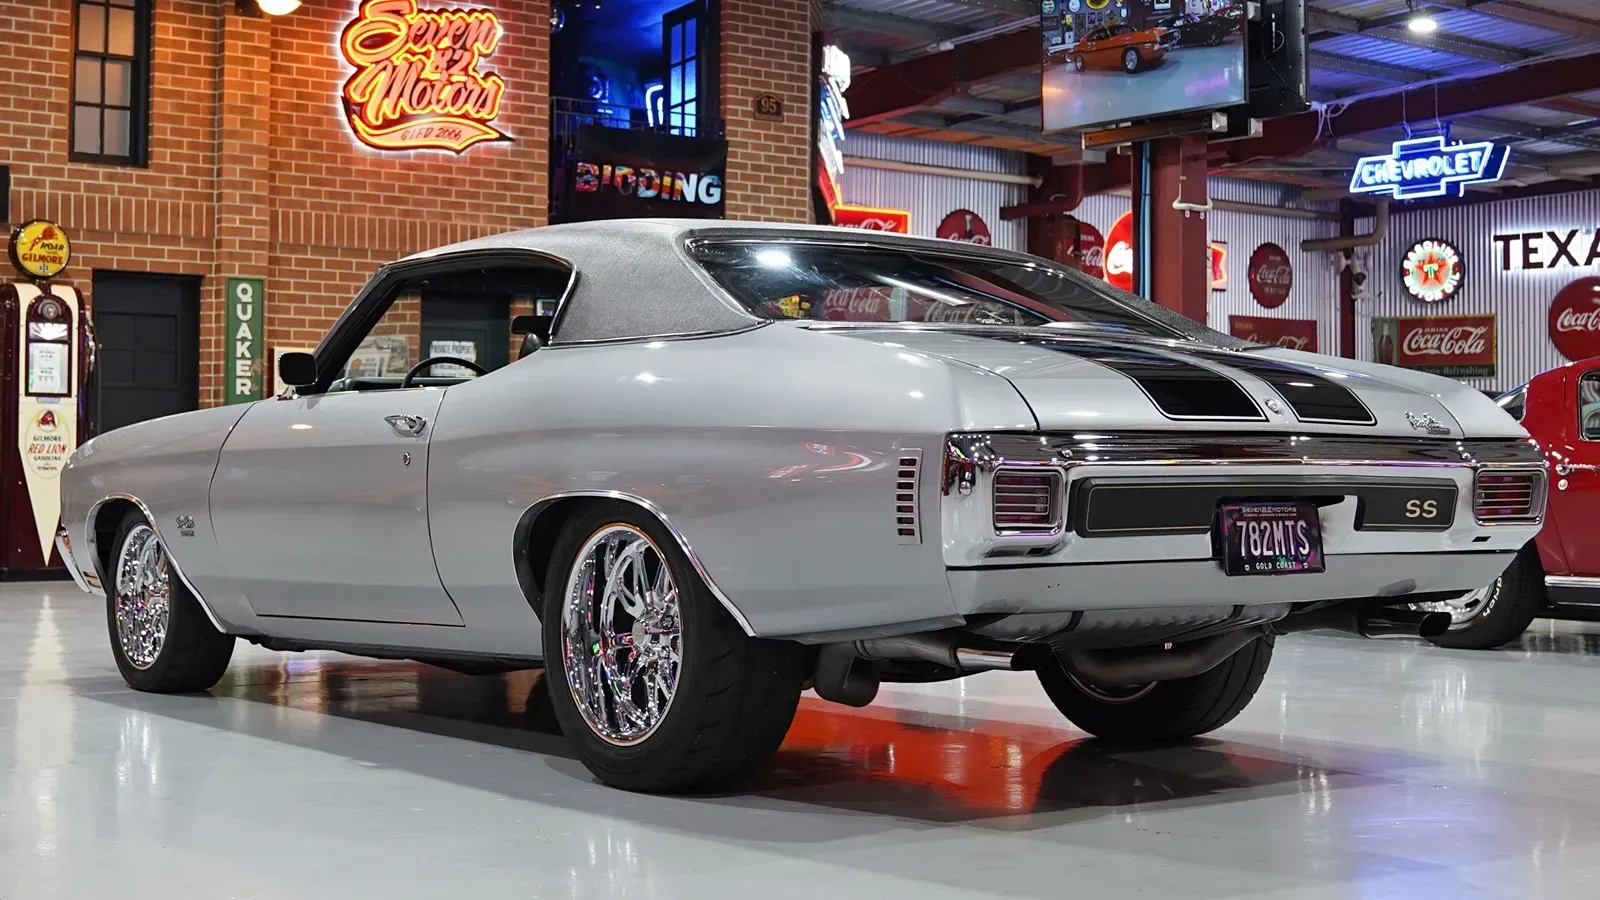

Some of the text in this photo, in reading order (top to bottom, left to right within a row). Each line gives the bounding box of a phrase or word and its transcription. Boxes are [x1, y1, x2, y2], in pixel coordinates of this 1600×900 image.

[347, 0, 502, 66] Seven
[431, 49, 471, 75] 82
[350, 60, 504, 125] Motors
[761, 97, 777, 113] 95
[1361, 151, 1482, 184] CHEVROLET
[575, 162, 722, 205] BIDDING
[22, 253, 63, 265] GILMORE
[40, 242, 64, 251] ROAR
[236, 282, 253, 396] QUAKER
[27, 443, 67, 454] RED LION
[1405, 499, 1437, 518] SS
[1236, 520, 1310, 557] 782MTS
[1256, 561, 1296, 570] GOLD COAST
